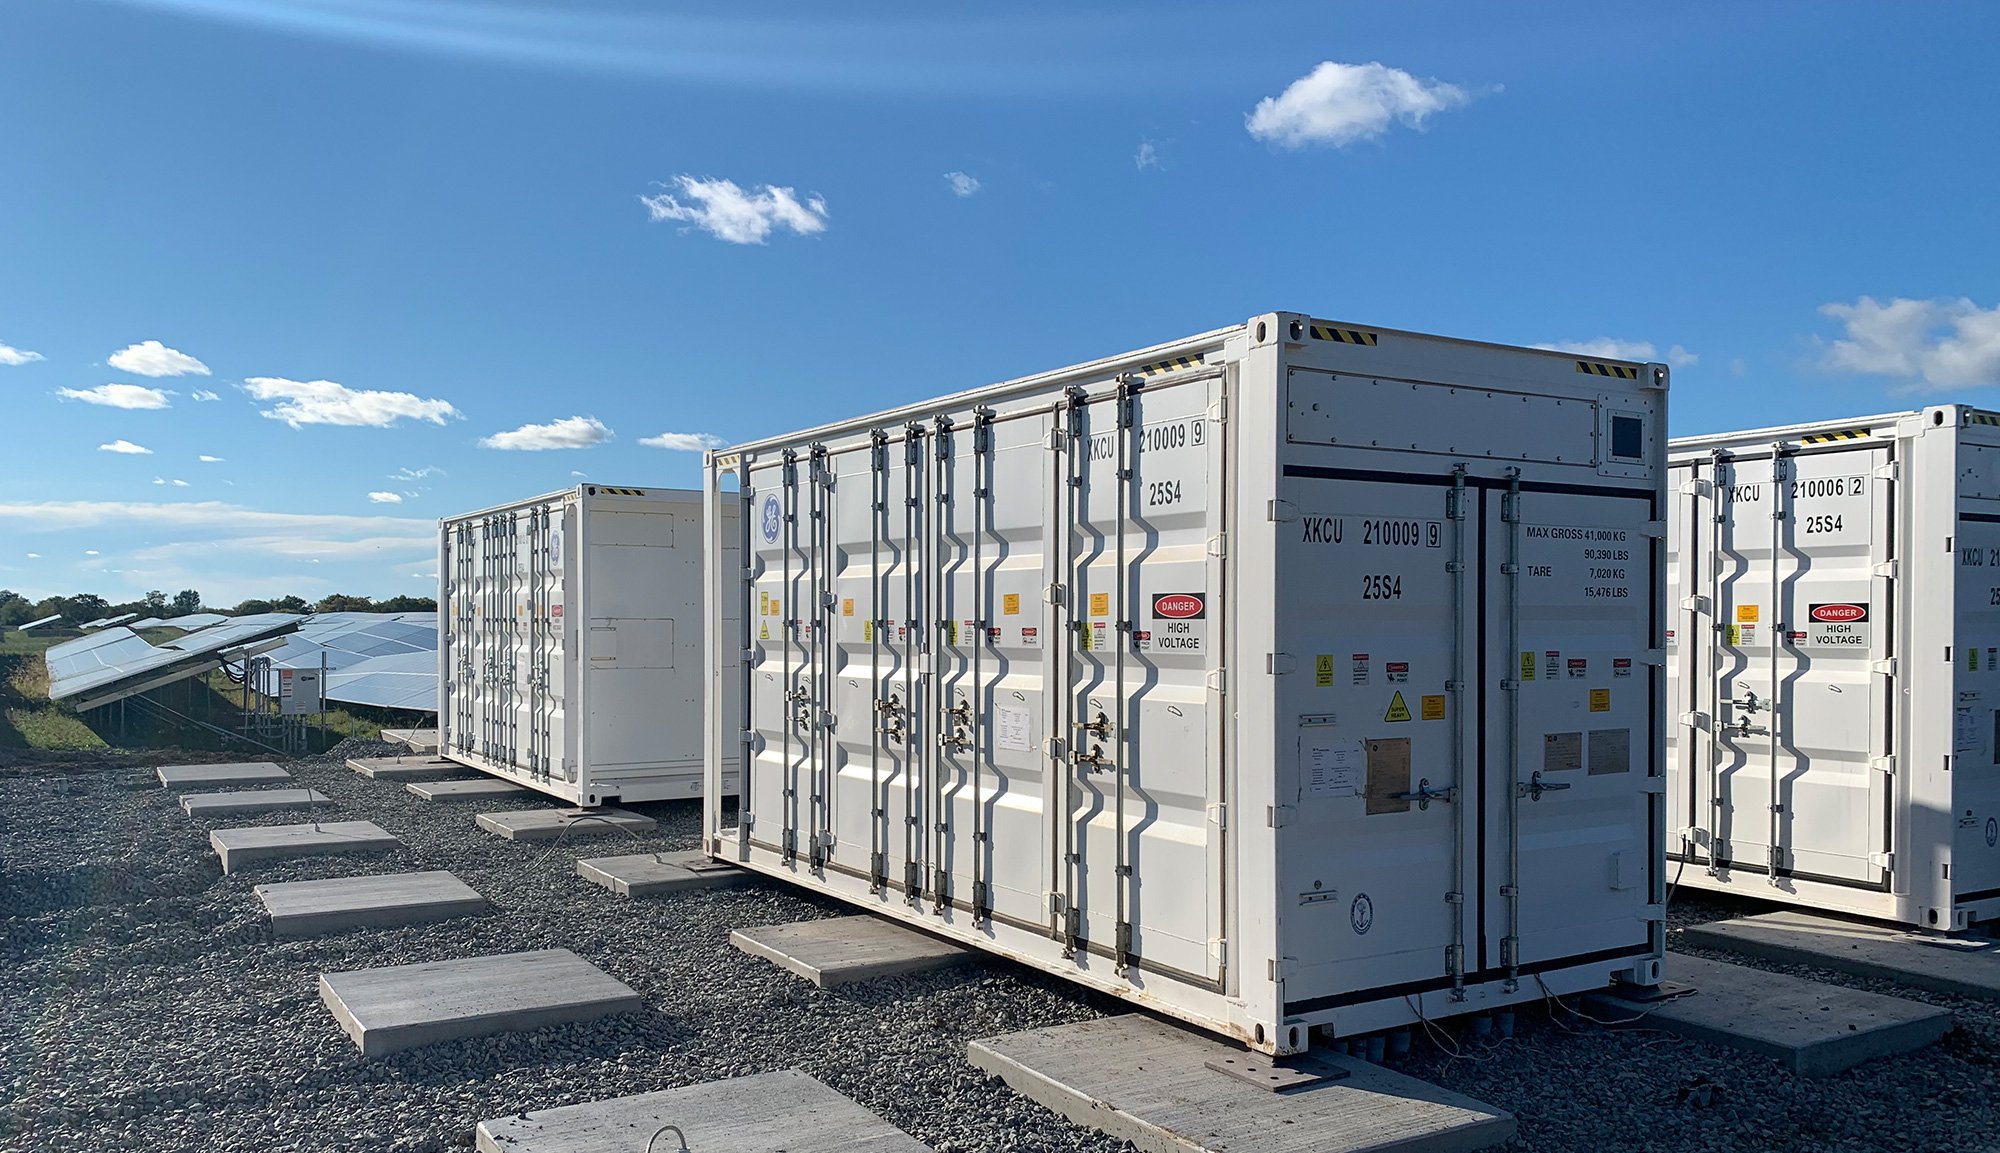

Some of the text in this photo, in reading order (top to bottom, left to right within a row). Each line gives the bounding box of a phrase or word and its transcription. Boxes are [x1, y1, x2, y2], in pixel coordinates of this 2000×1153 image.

[1087, 422, 1202, 462] XKCU 210009 9
[1149, 480, 1182, 506] 25S4
[1728, 479, 1862, 503] XKCU 210006 2
[1302, 517, 1438, 546] XKCU 210009 9
[1806, 515, 1843, 533] 25S4
[1526, 526, 1626, 542] MAX GROSS 41,000 KG
[1584, 549, 1629, 561] 90,390 LBS
[1961, 549, 1983, 566] XKCU
[1527, 565, 1625, 580] TARE 7,020 KG
[1362, 575, 1402, 600] 25S4
[1584, 586, 1628, 598] 15,476 LBS
[1162, 601, 1195, 611] DANGER
[1820, 609, 1857, 617] DANGER
[1167, 622, 1190, 633] HIGH
[1826, 625, 1851, 633] HIGH
[1158, 637, 1200, 649] VOLTAGE
[1816, 635, 1862, 644] VOLTAGE
